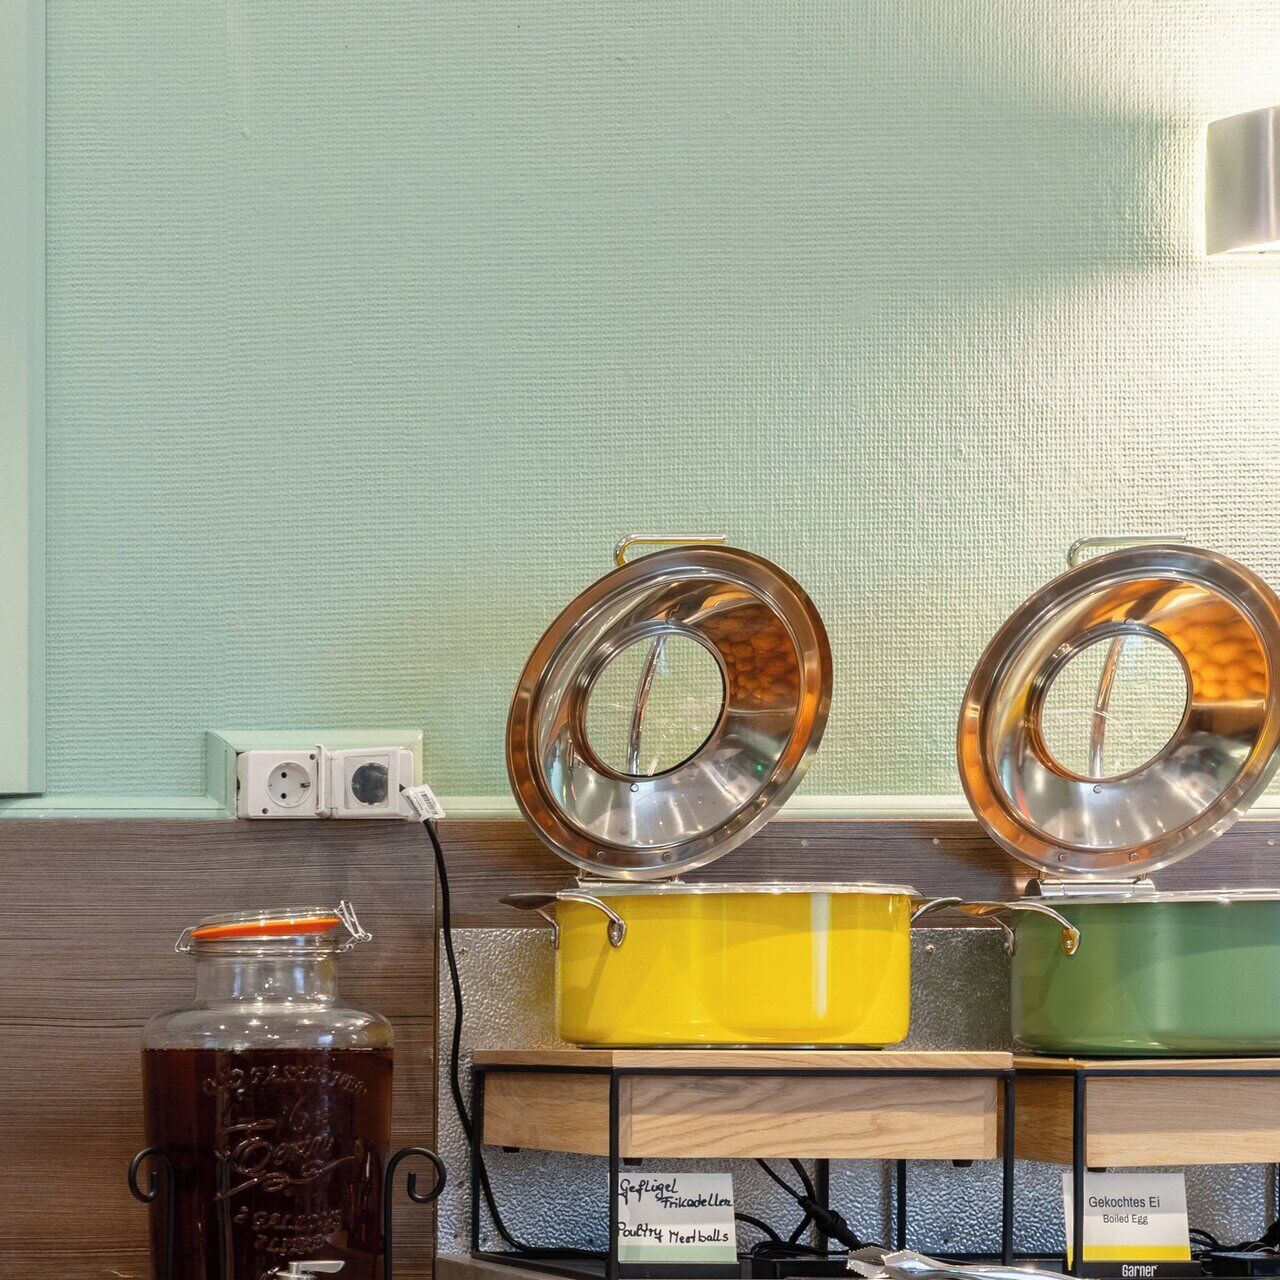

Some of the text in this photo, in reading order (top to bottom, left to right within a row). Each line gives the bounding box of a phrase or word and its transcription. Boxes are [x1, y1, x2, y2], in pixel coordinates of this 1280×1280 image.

[618, 1178, 679, 1205] Geflügel
[658, 1193, 733, 1209] Frikadellen
[1089, 1196, 1160, 1208] Gekochtes Ei
[1103, 1214, 1149, 1226] Boiled Egg
[618, 1221, 663, 1243] Poultry
[1122, 1264, 1158, 1277] Garner
